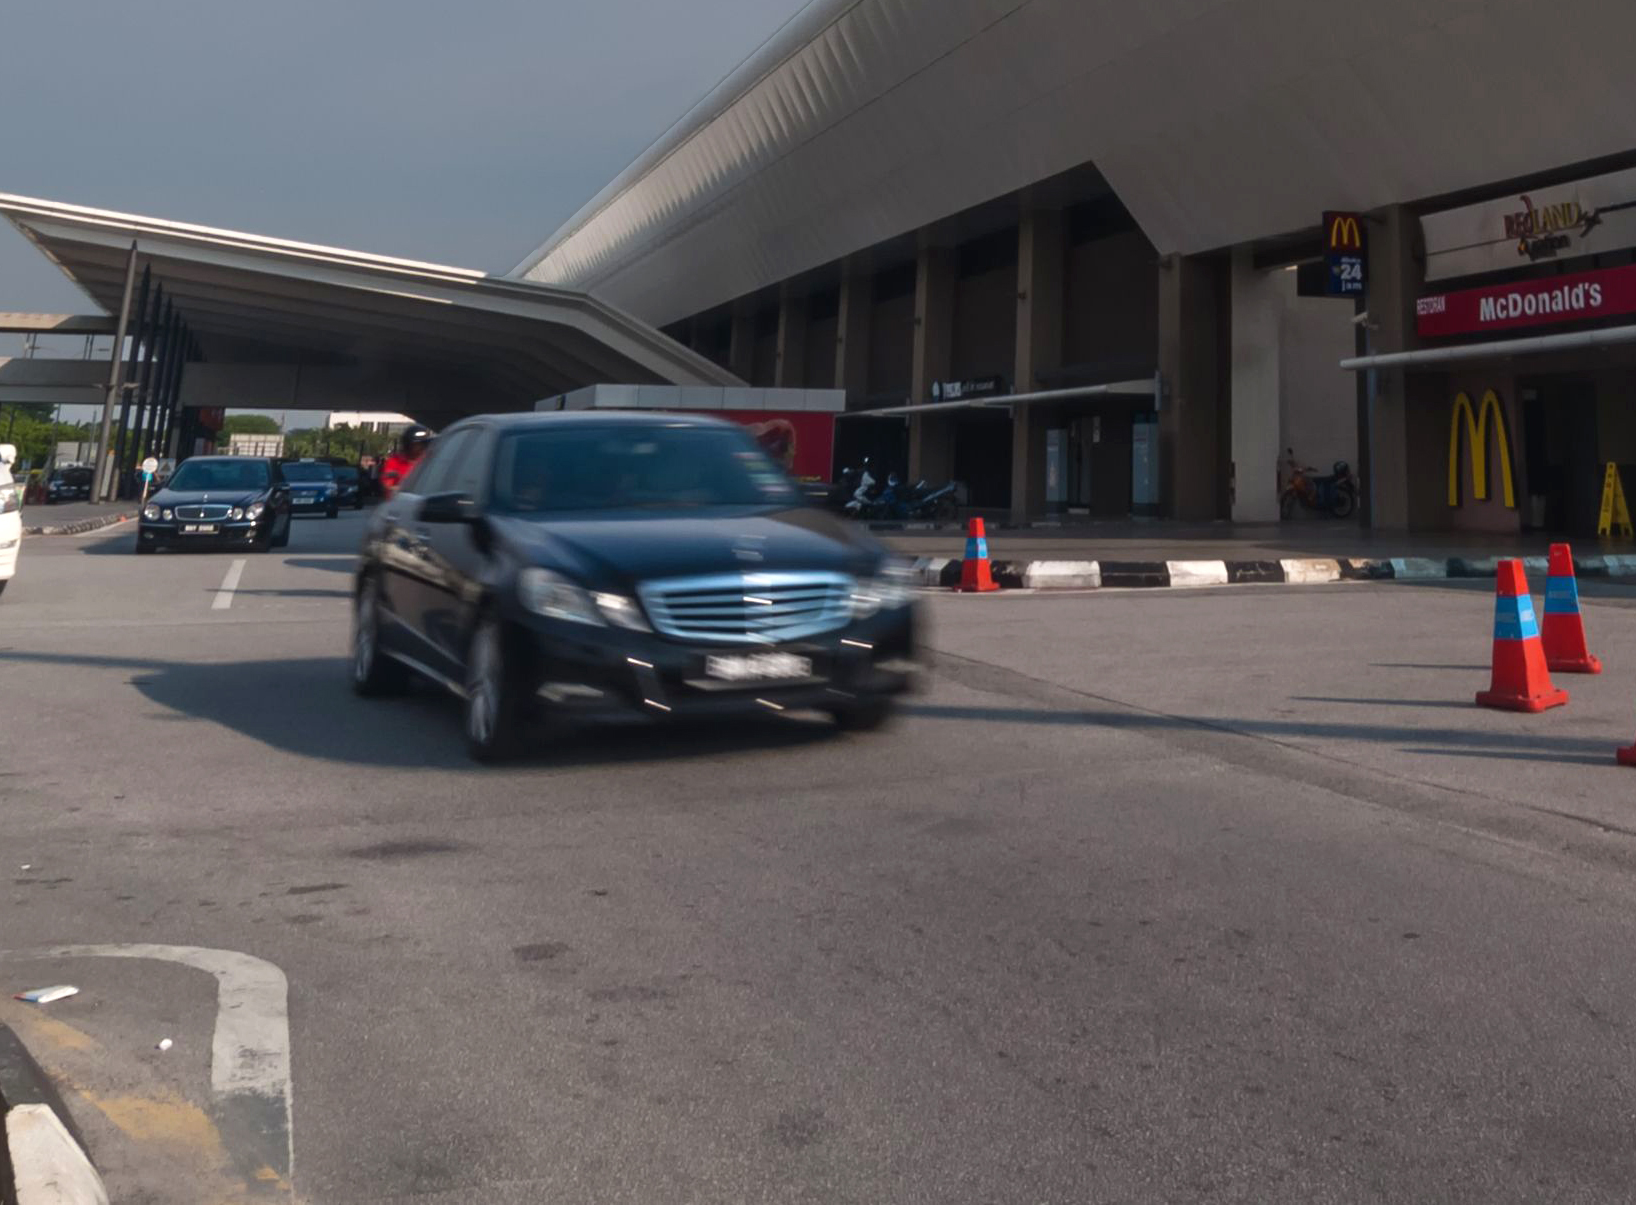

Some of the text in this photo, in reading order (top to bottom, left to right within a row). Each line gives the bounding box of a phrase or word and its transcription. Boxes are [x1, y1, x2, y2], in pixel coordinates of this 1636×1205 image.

[1340, 264, 1362, 280] 24
[1416, 282, 1602, 322] RESTORAN McDonald's
